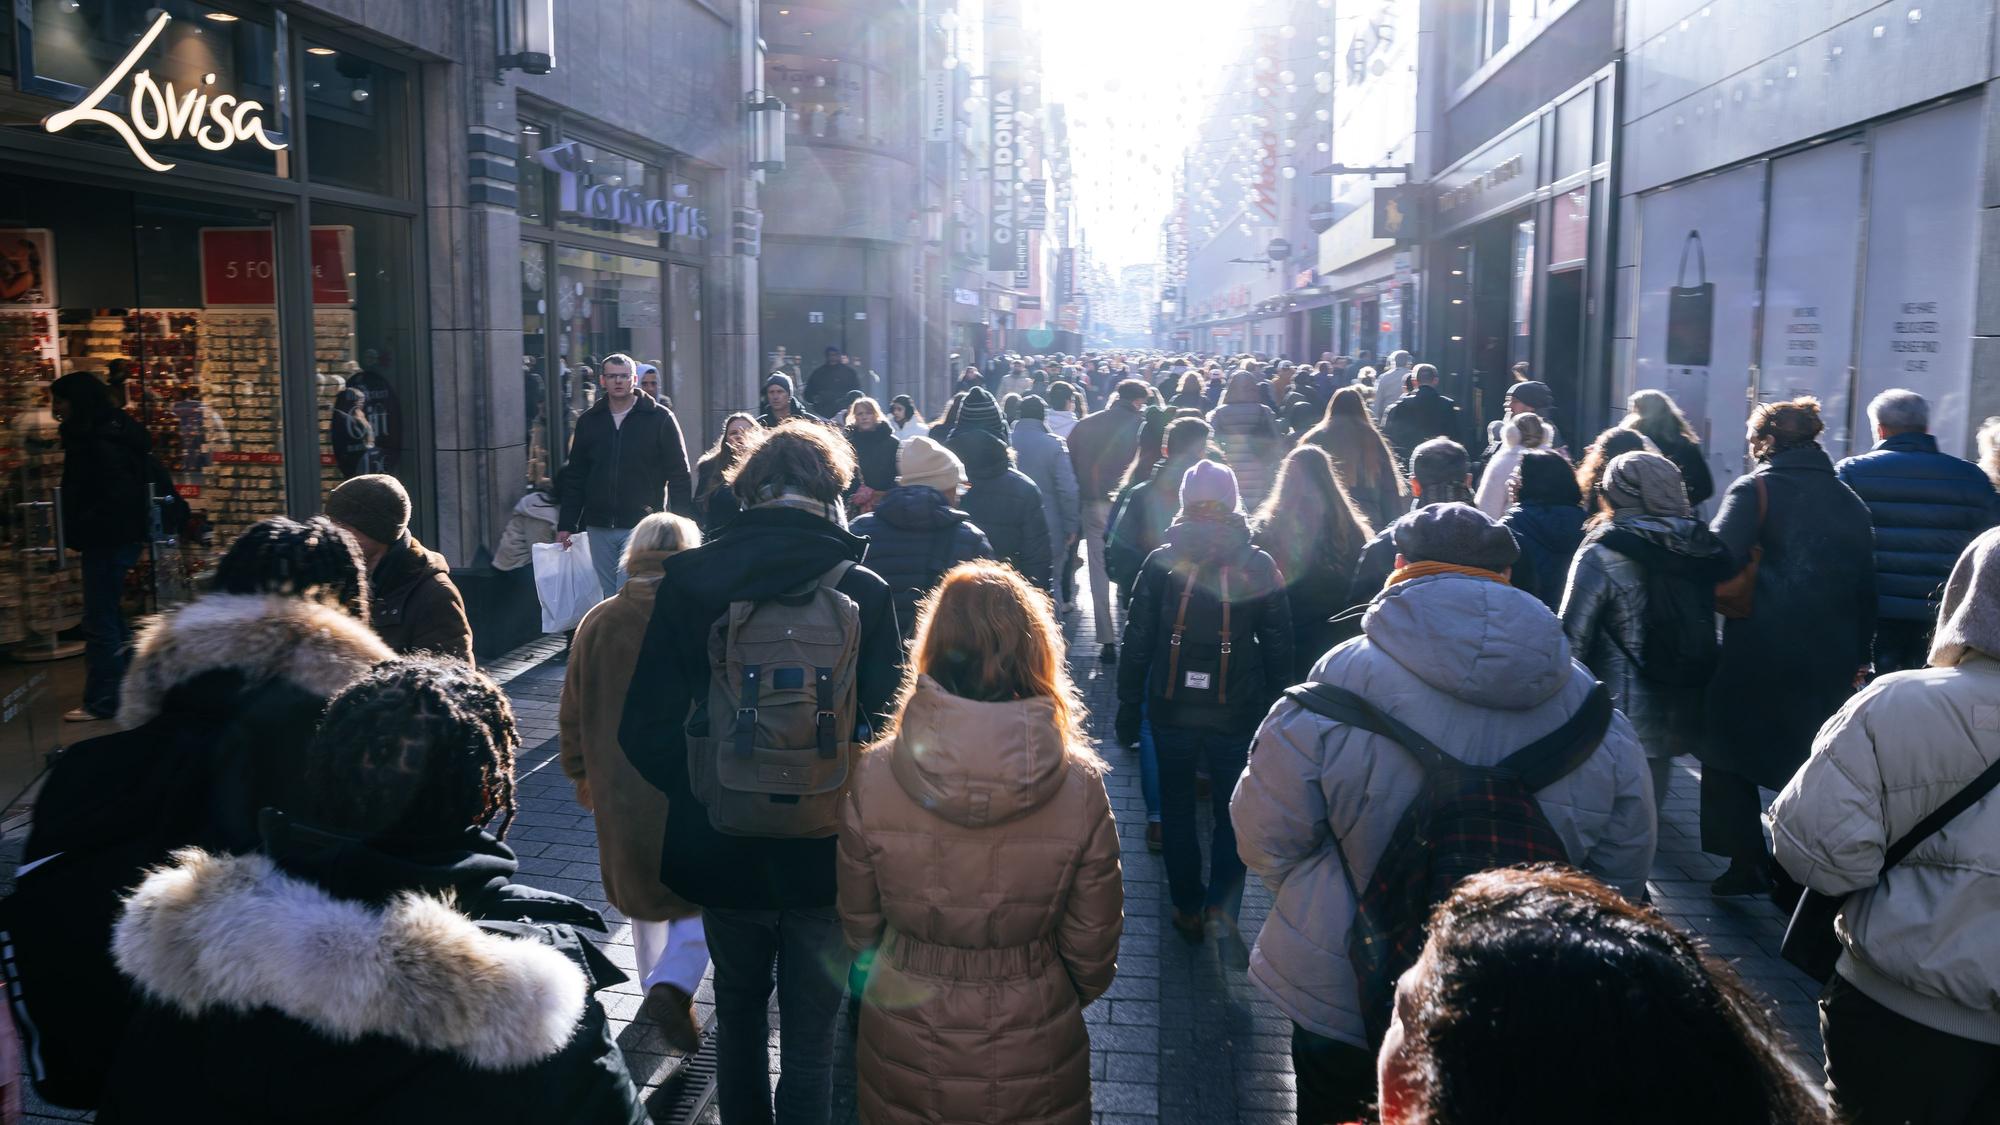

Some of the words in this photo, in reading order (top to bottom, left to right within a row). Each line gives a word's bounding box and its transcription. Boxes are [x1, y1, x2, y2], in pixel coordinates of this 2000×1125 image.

[44, 10, 289, 172] Lovisa
[993, 89, 1015, 245] CALZEDONIA
[225, 261, 238, 279] 5
[246, 261, 273, 279] FO
